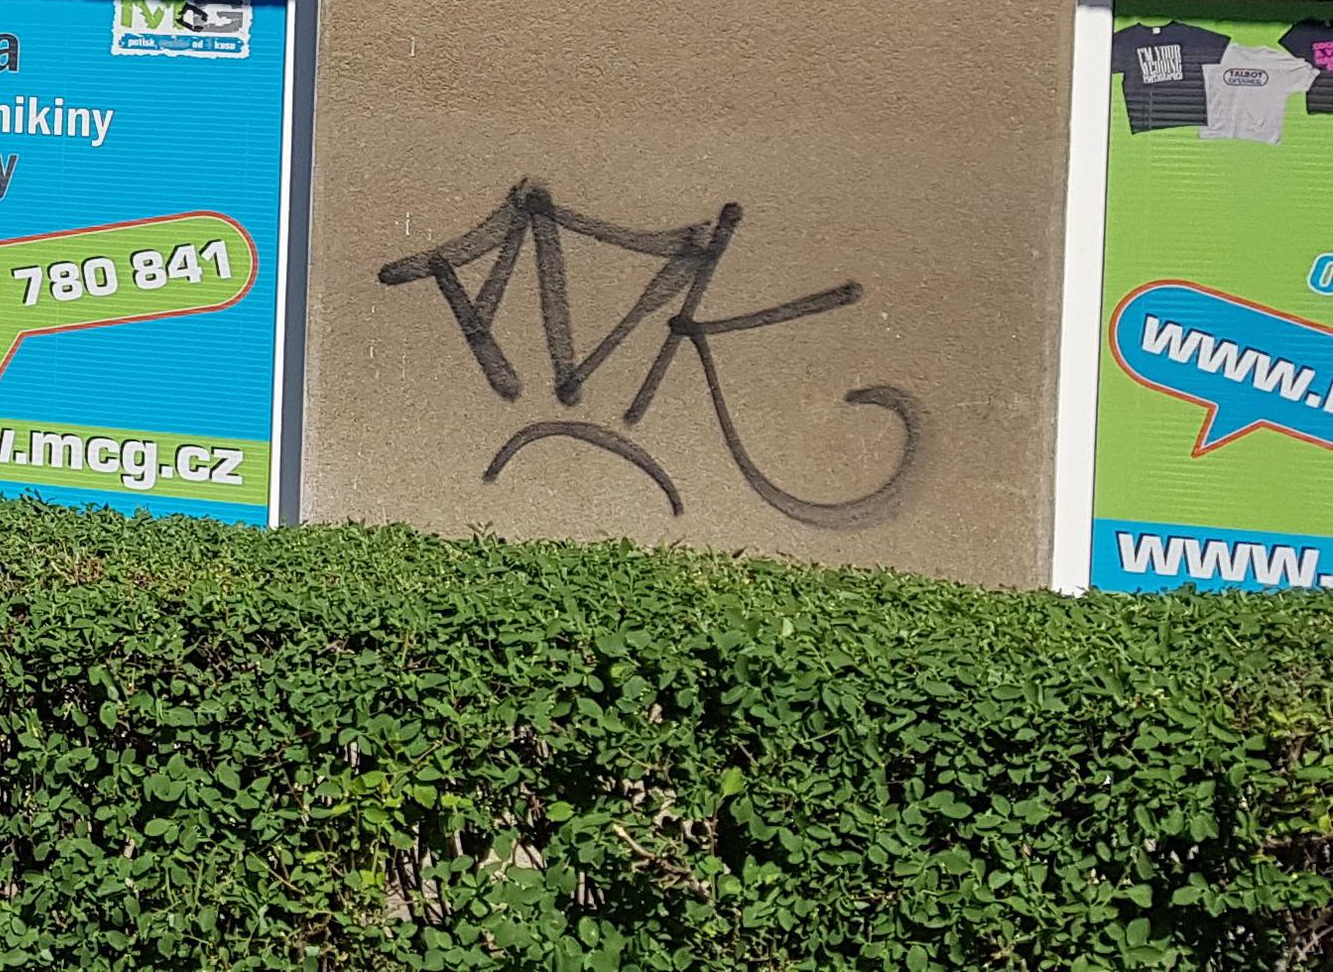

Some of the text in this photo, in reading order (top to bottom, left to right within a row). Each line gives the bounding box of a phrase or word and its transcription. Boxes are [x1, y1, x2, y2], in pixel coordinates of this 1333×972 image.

[11, 255, 118, 309] 780
[130, 237, 234, 295] 841
[1141, 313, 1333, 414] www.
